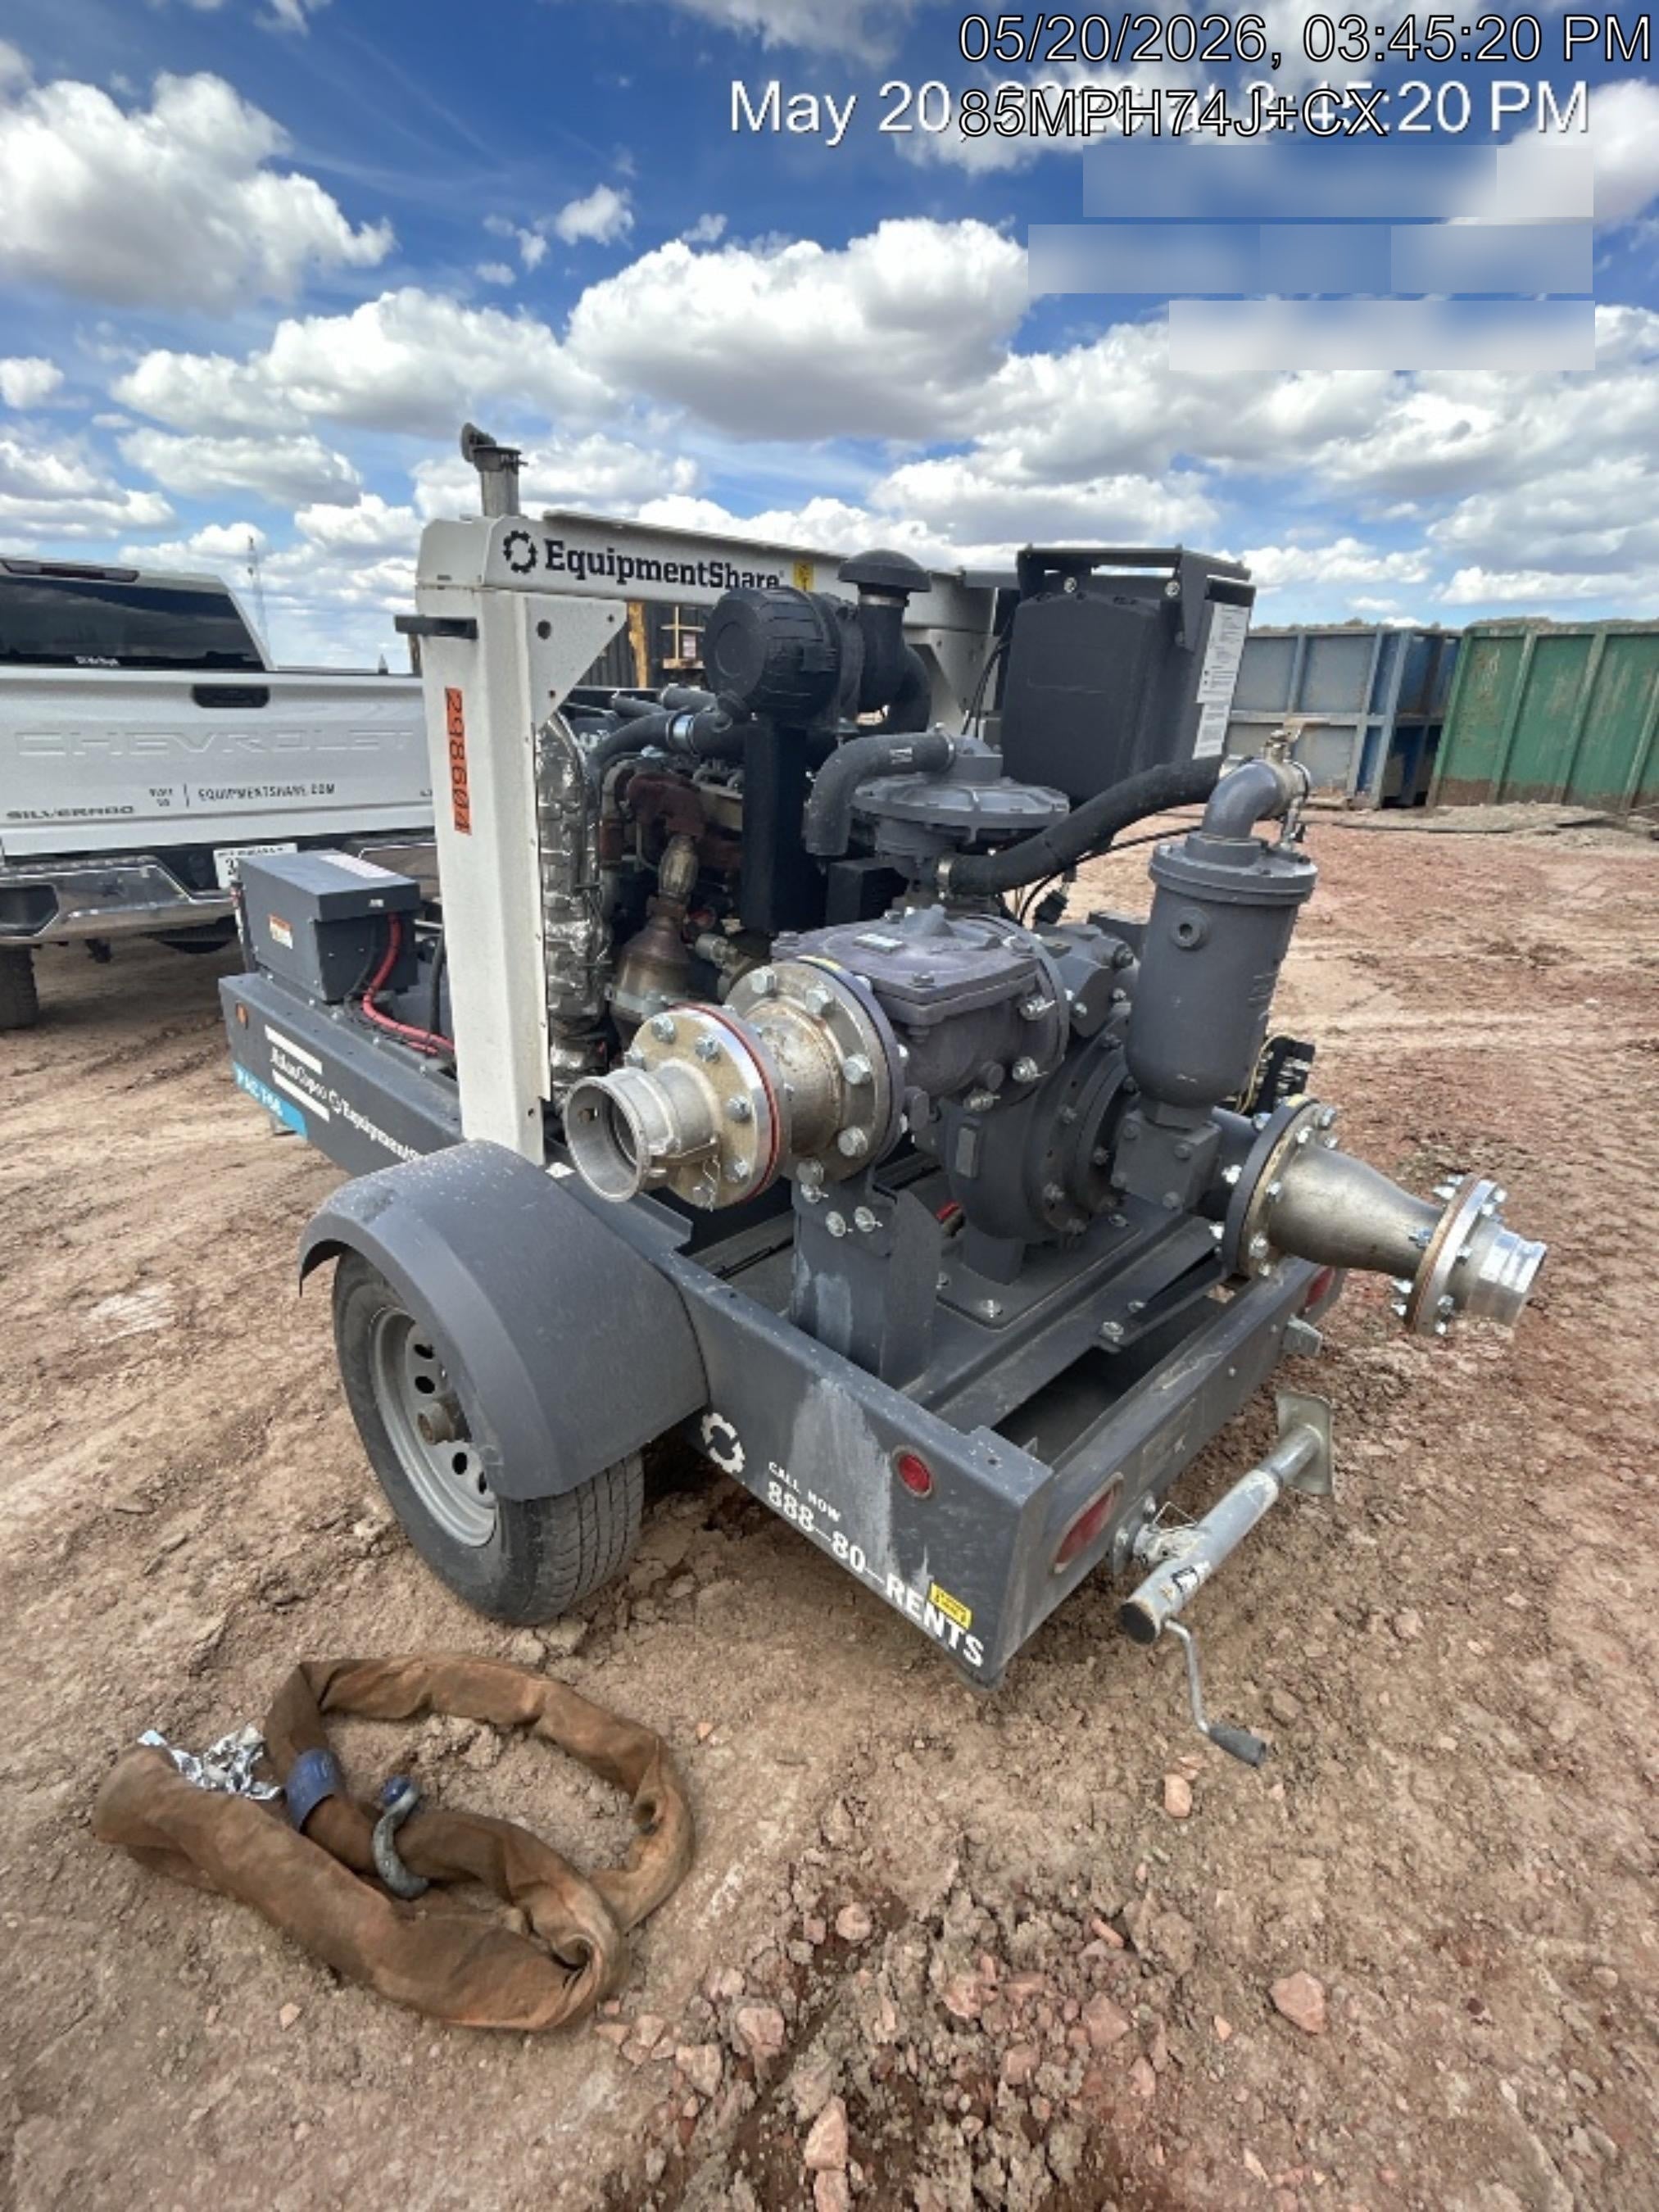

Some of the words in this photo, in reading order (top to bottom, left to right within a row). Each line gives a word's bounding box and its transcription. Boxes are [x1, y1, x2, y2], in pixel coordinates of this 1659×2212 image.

[544, 538, 780, 589] EquipmentShare
[15, 730, 414, 756] CHEVROLET
[6, 805, 134, 819] SILVERADO
[768, 1462, 801, 1495] CALL
[807, 1489, 841, 1522] NOW
[768, 1481, 983, 1667] 888-80-RENTS
